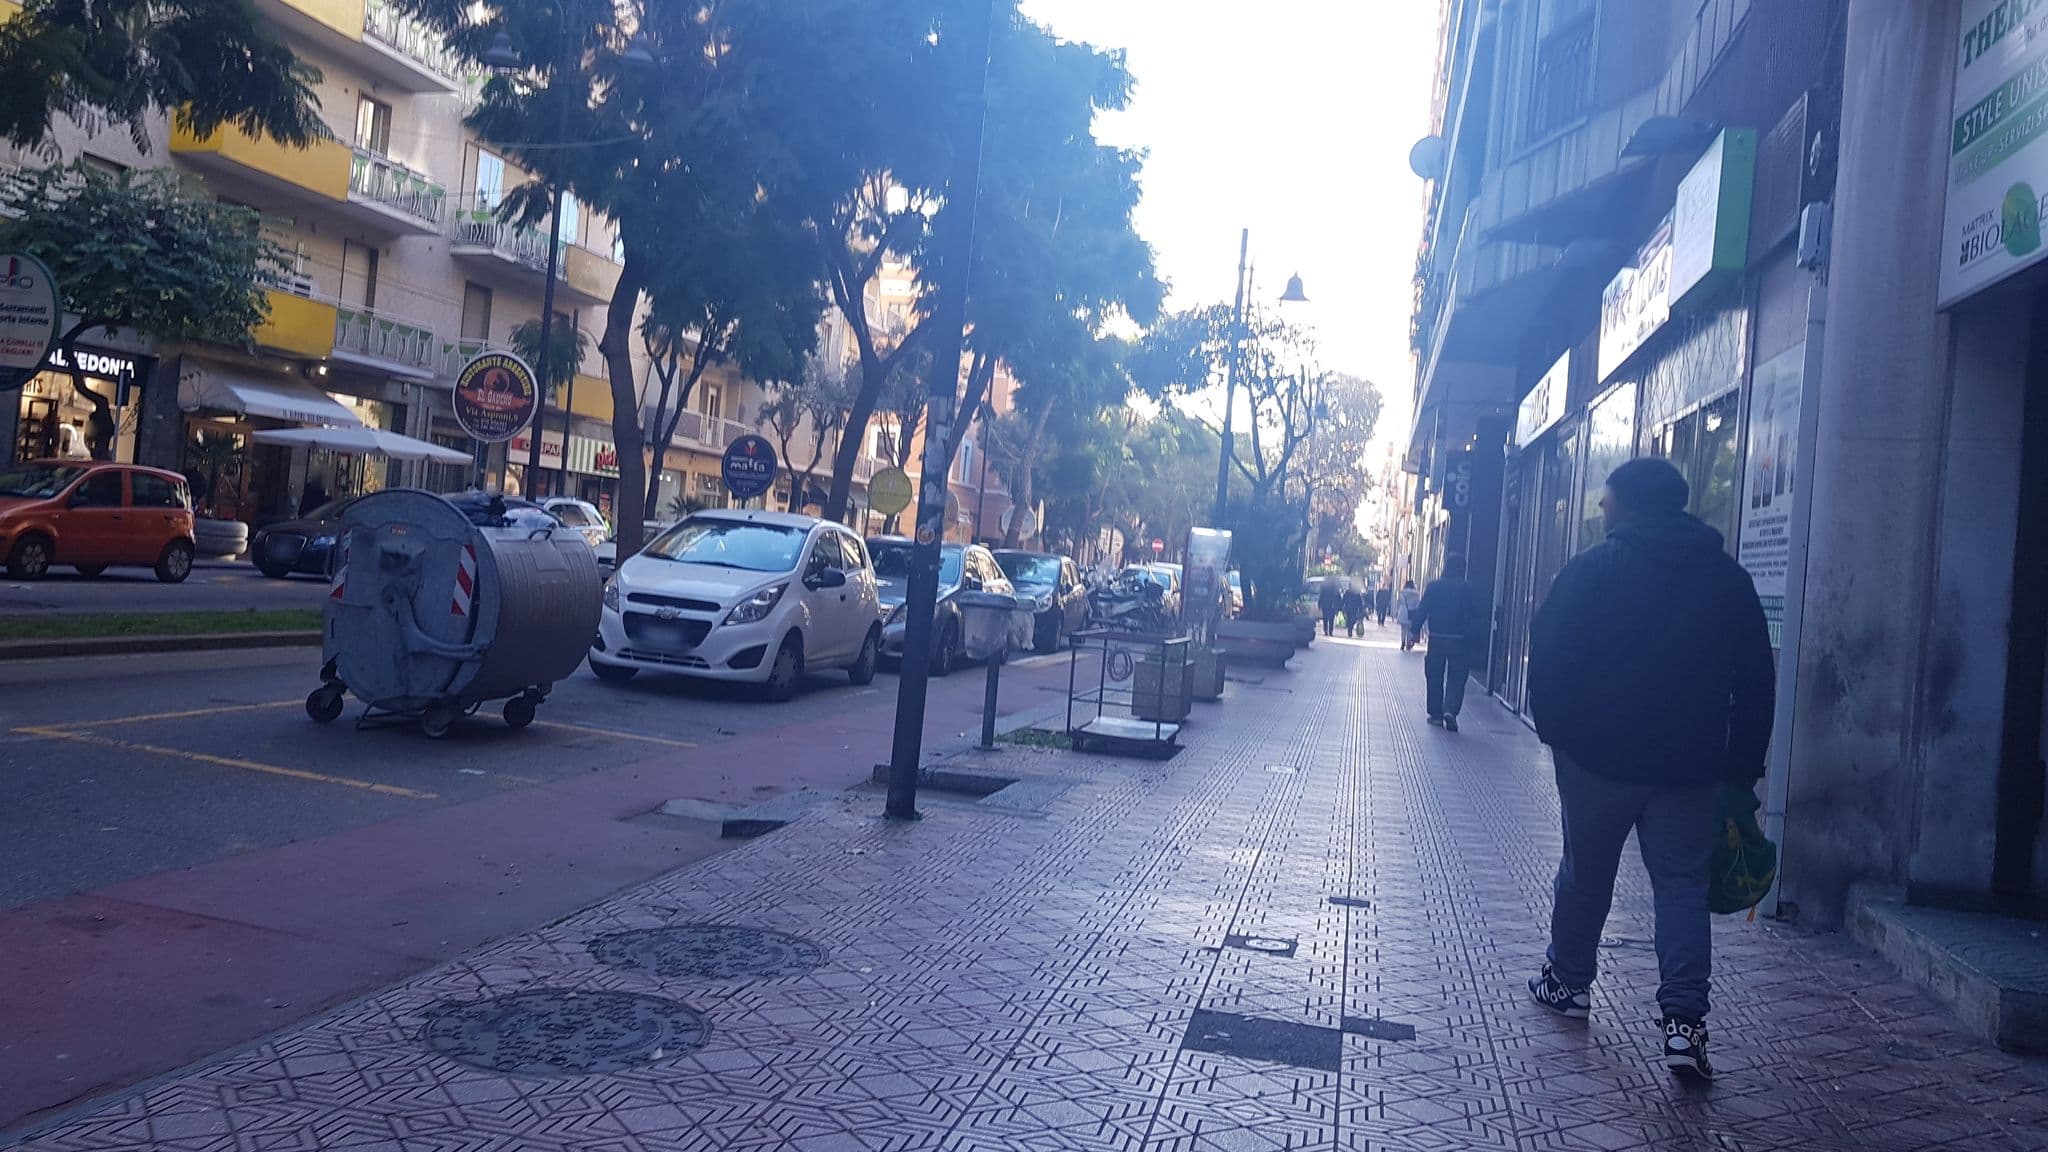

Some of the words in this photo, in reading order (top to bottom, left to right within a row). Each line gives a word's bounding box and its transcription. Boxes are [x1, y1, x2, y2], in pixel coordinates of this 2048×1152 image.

[1963, 90, 2003, 143] STYLE
[2000, 114, 2034, 150] SERVIZI
[1961, 207, 1995, 238] MATRIX
[1446, 459, 1472, 508] coin
